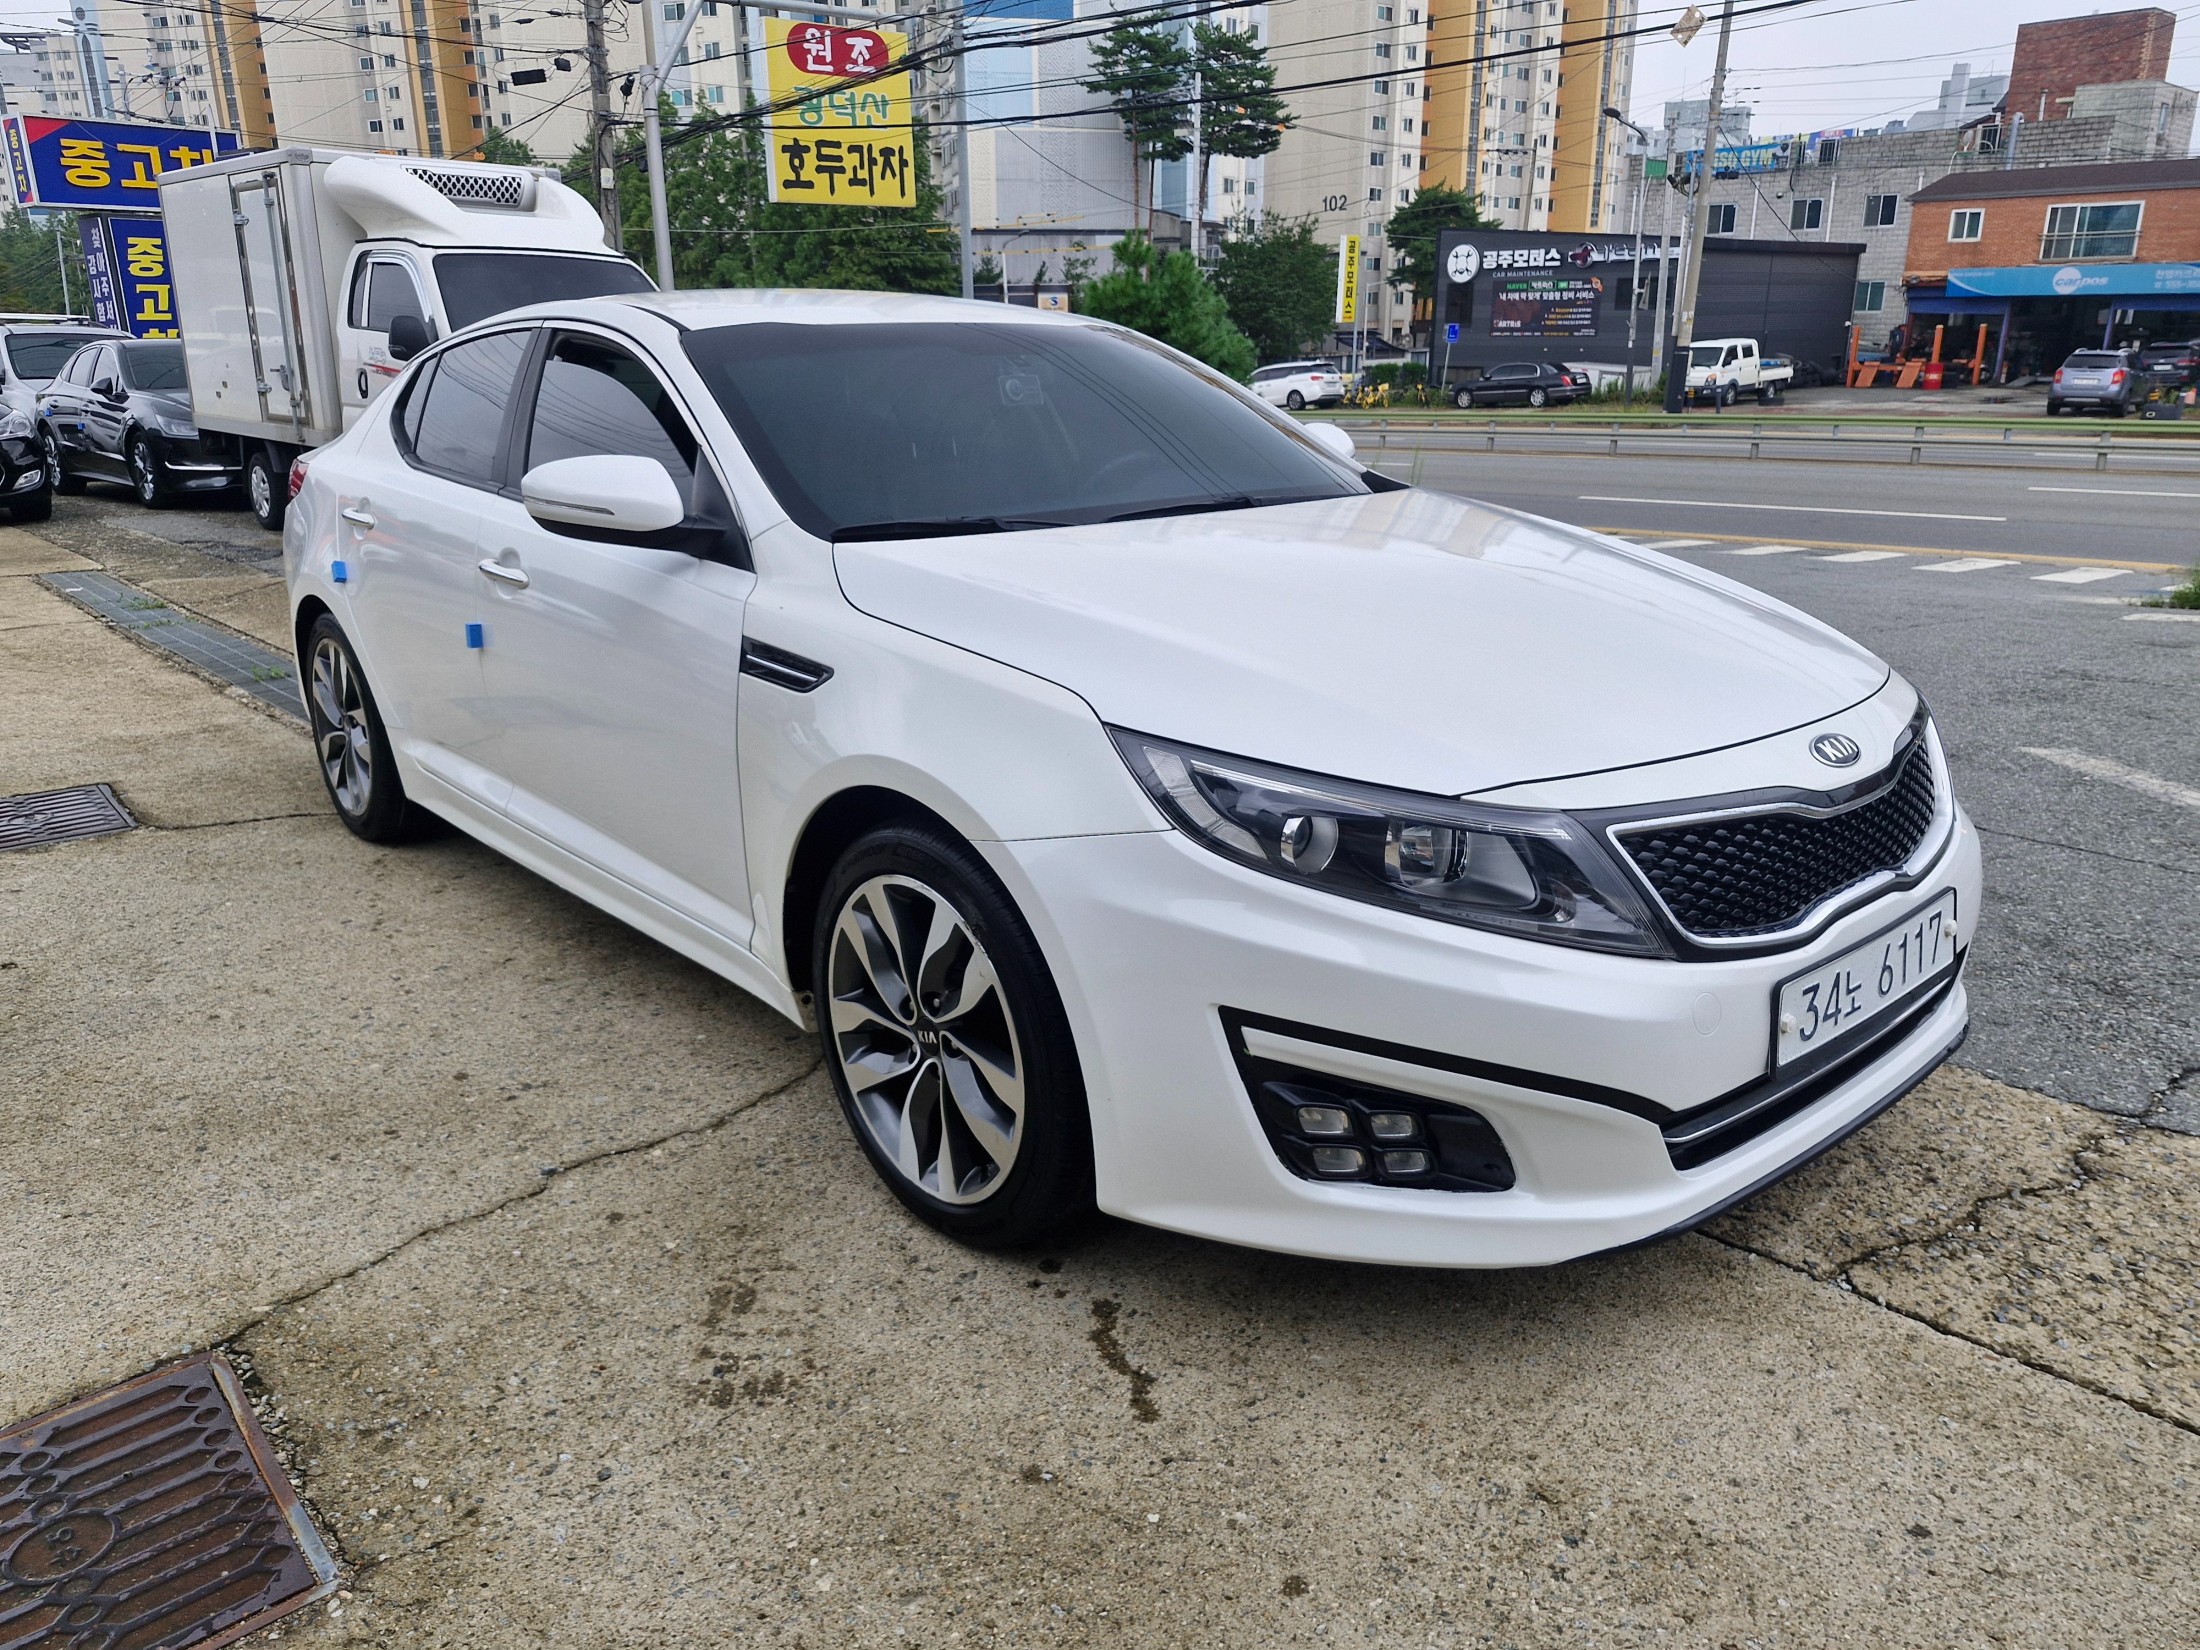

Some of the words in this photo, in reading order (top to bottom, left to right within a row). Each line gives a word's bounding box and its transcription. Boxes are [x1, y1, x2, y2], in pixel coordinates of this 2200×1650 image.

[803, 28, 877, 72] 원조
[9, 128, 28, 192] 중고차
[781, 138, 909, 199] 호두과자
[1741, 148, 1775, 167] GYM
[1322, 194, 1347, 211] 102
[1482, 247, 1561, 269] 공주모터스
[1344, 240, 1356, 314] 공주모터스
[1507, 269, 1553, 277] MAINTENANCE
[127, 236, 179, 338] 중고
[1576, 290, 1595, 299] 서비스
[1816, 735, 1858, 761] KIA
[1800, 969, 1862, 1041] 34노
[1879, 910, 1942, 998] 6117
[917, 1029, 938, 1044] KIA
